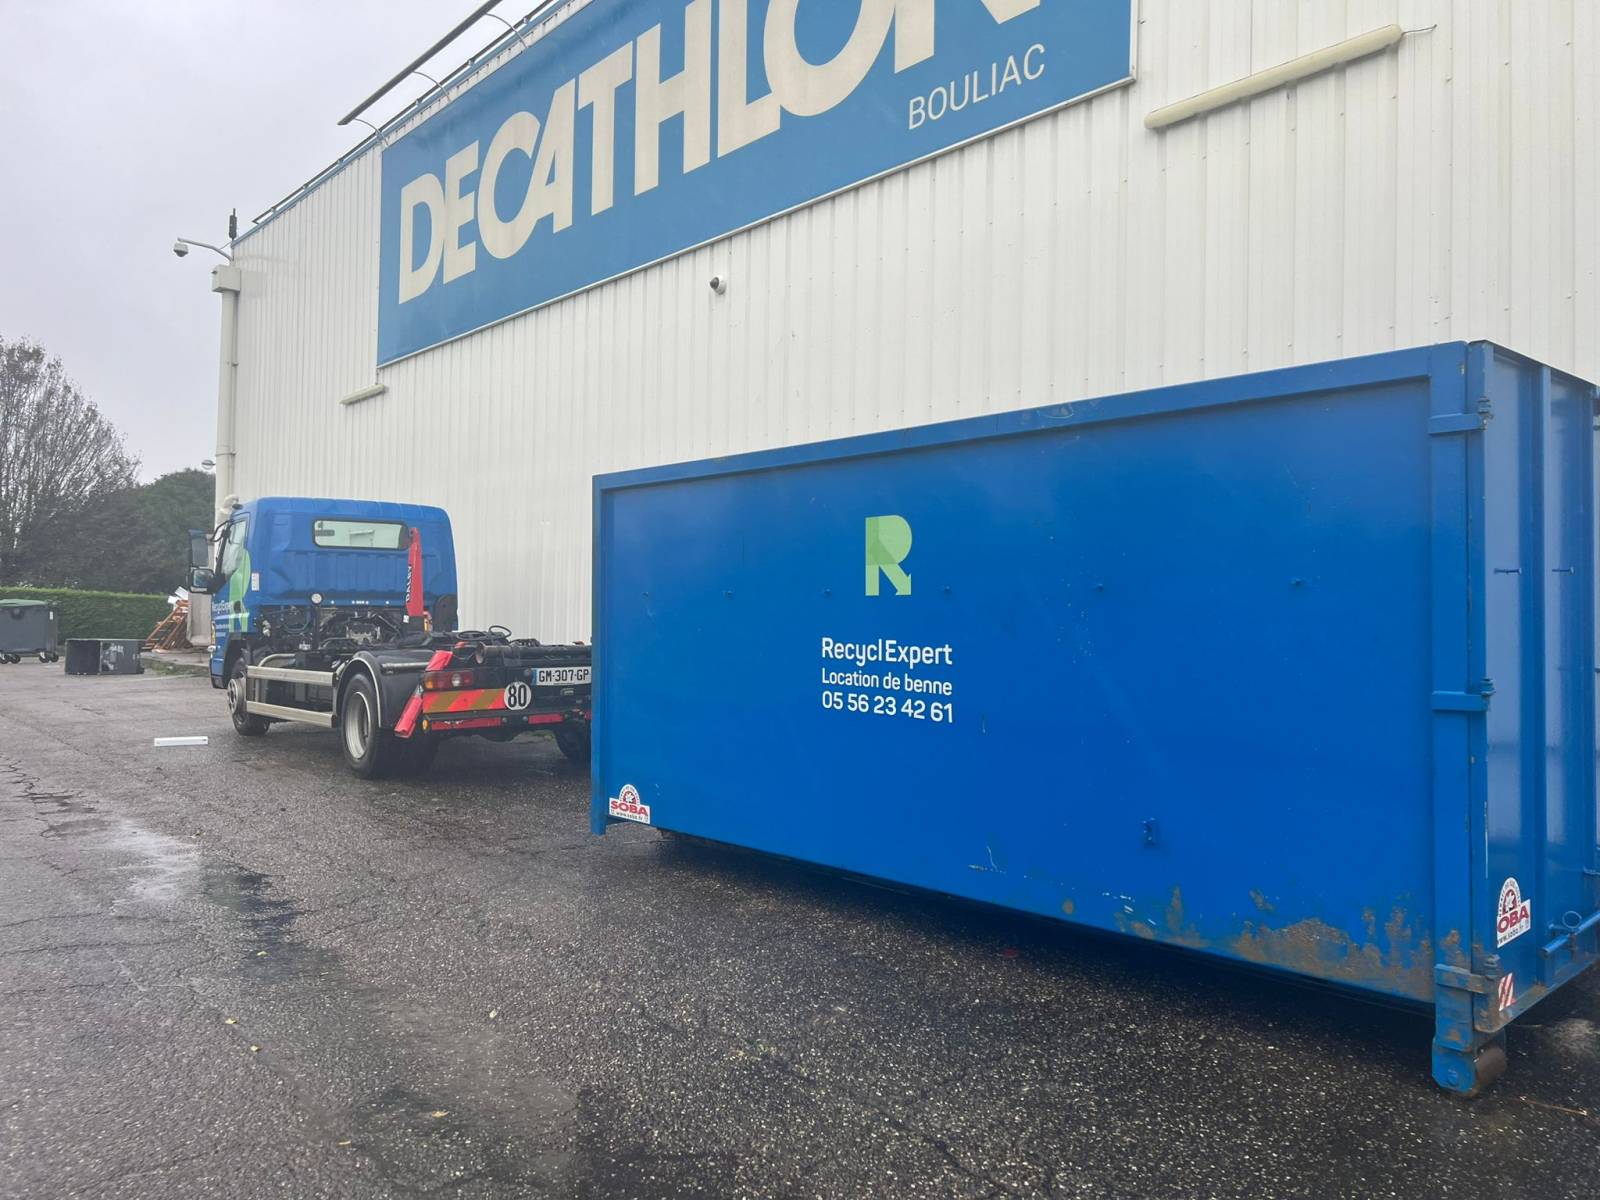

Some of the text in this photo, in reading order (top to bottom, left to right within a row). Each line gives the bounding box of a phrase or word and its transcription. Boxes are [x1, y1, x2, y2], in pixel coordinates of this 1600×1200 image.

[908, 43, 1045, 130] BOULIAC
[398, 0, 1041, 304] DECATHLO
[822, 637, 953, 669] RecyclExpert
[538, 669, 589, 682] GM-307-GP
[822, 667, 952, 695] Location de benne
[508, 684, 527, 708] 80
[822, 691, 953, 723] 05 56 23 42 61
[610, 800, 649, 817] SOBA
[1498, 905, 1529, 933] OBA
